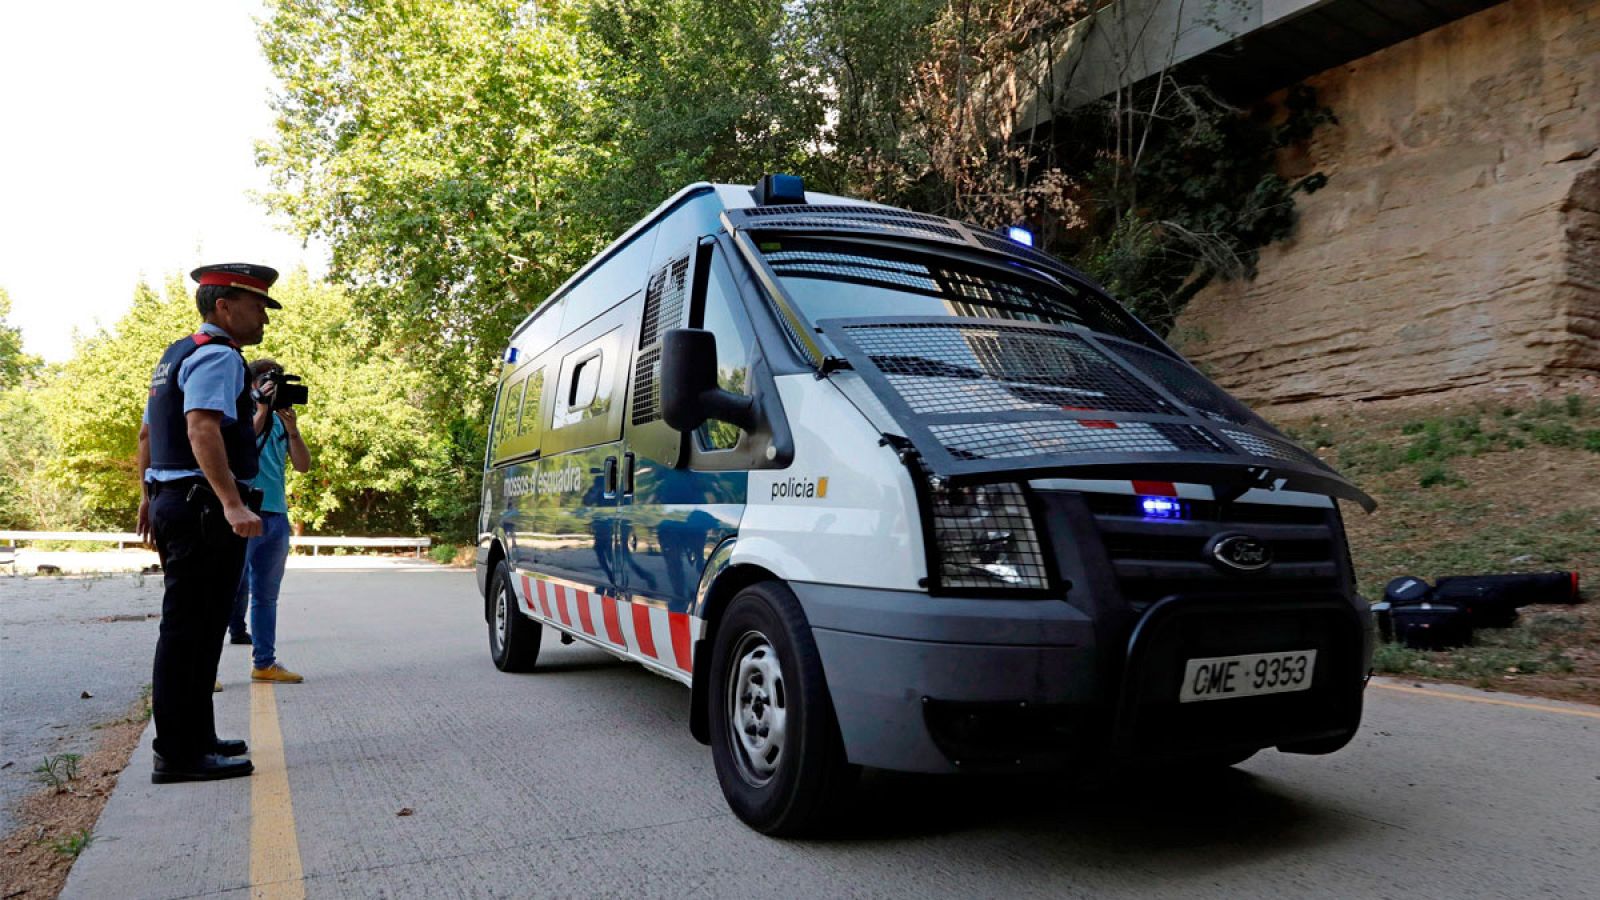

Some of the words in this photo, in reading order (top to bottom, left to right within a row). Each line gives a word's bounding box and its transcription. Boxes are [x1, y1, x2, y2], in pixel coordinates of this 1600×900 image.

[503, 475, 529, 496] mossos
[771, 476, 814, 501] policia
[1232, 542, 1265, 562] Ford
[1193, 660, 1240, 695] CME
[1253, 655, 1307, 689] 9353
